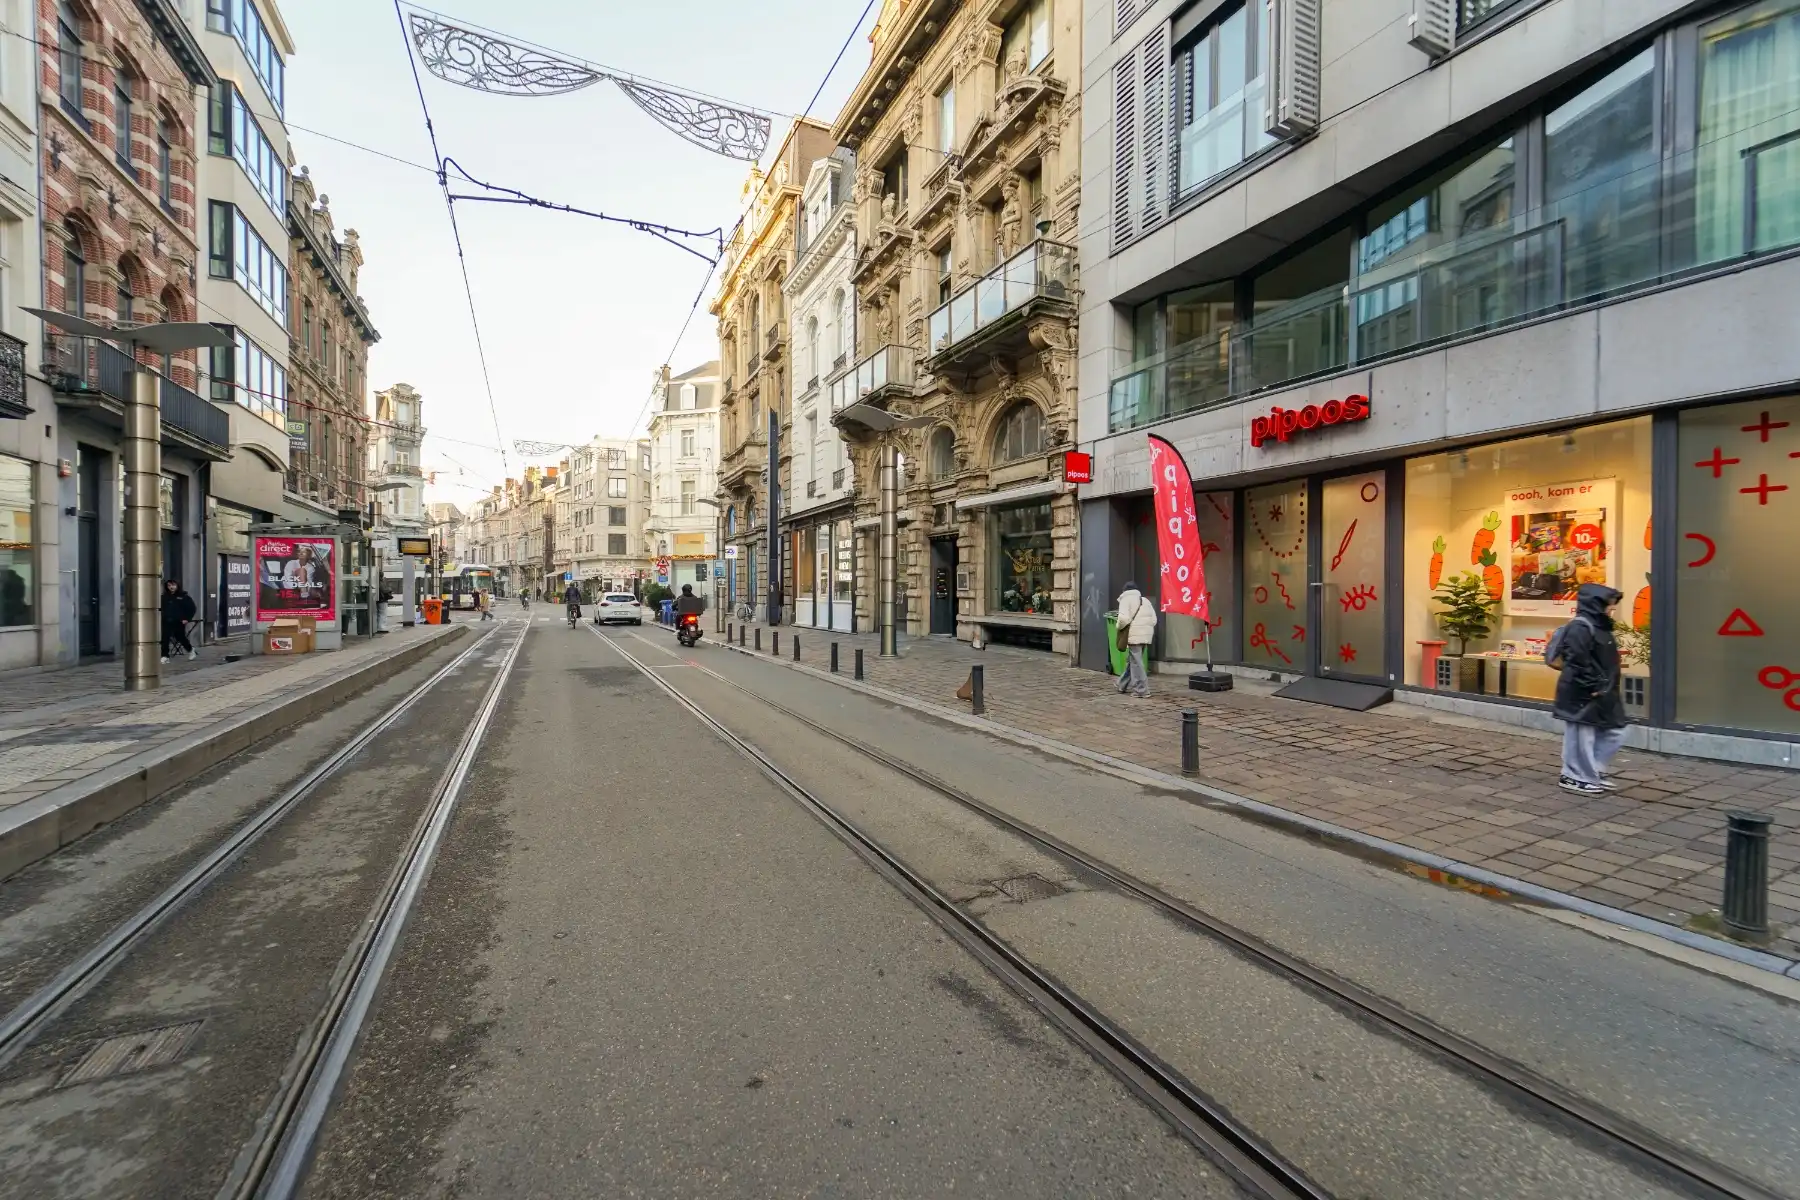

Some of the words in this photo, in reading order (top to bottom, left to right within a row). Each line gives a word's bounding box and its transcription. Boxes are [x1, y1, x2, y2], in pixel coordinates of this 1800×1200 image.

[1251, 394, 1370, 448] pipoos
[1067, 469, 1089, 479] pipoos
[1511, 489, 1544, 501] oooh,
[1547, 487, 1574, 498] kom
[1579, 484, 1593, 494] er
[260, 544, 291, 553] direct
